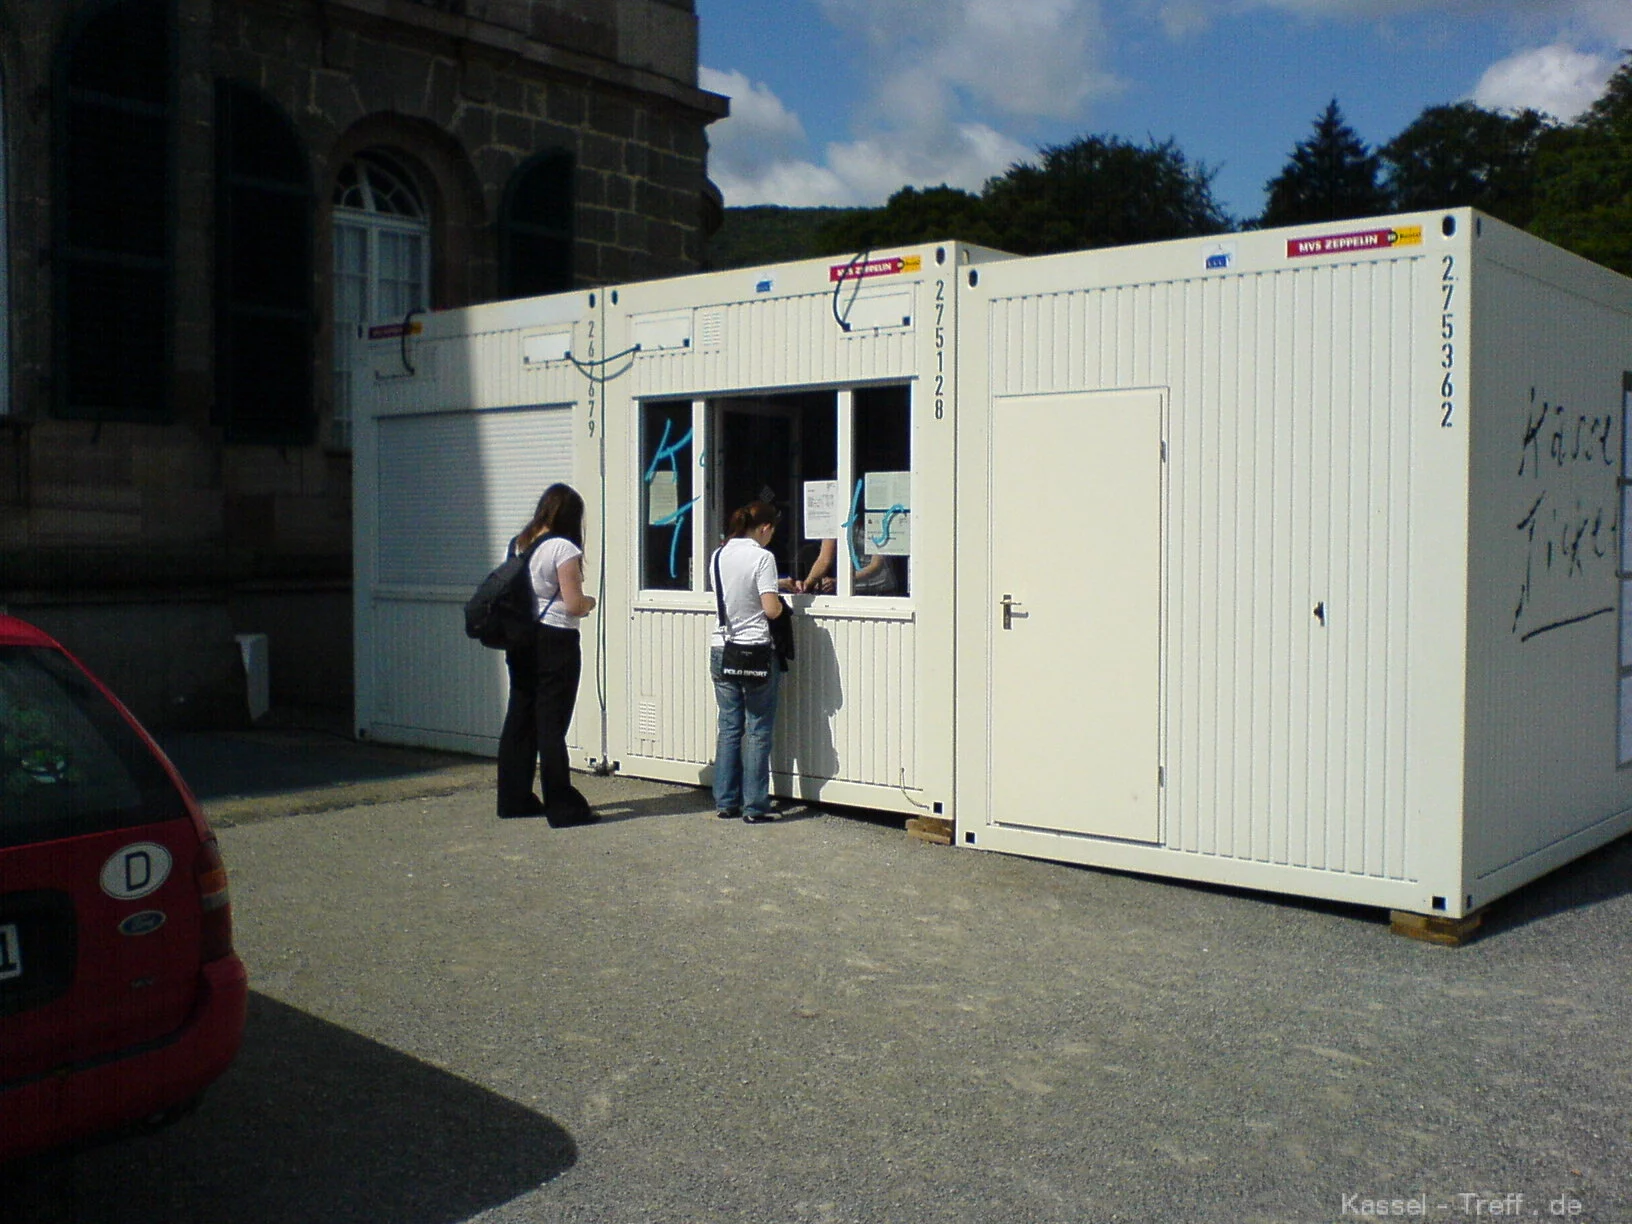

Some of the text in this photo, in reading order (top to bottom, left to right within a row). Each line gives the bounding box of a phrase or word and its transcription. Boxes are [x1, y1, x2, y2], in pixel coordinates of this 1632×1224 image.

[1299, 240, 1322, 253] MVS
[1325, 234, 1379, 250] ZEPPELIN
[935, 279, 944, 420] 275128
[1440, 254, 1454, 428] 275362
[723, 668, 768, 678] POLO SPORT
[124, 850, 151, 892] D
